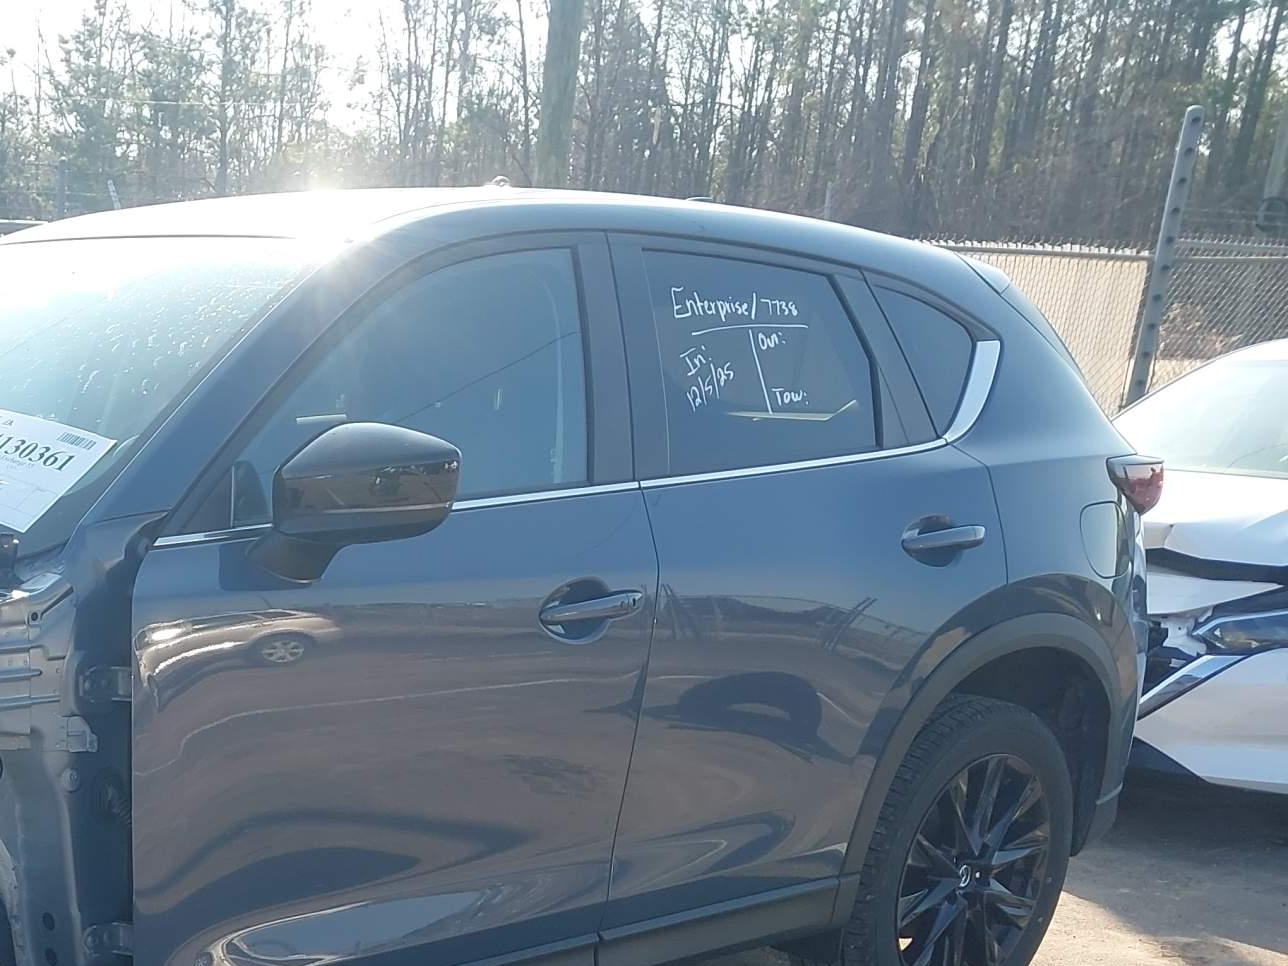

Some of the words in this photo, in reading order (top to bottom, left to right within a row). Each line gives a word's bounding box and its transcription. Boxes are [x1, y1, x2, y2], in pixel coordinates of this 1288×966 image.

[679, 344, 712, 376] In:
[686, 361, 735, 413] 12/5/25
[771, 388, 809, 407] Tow:
